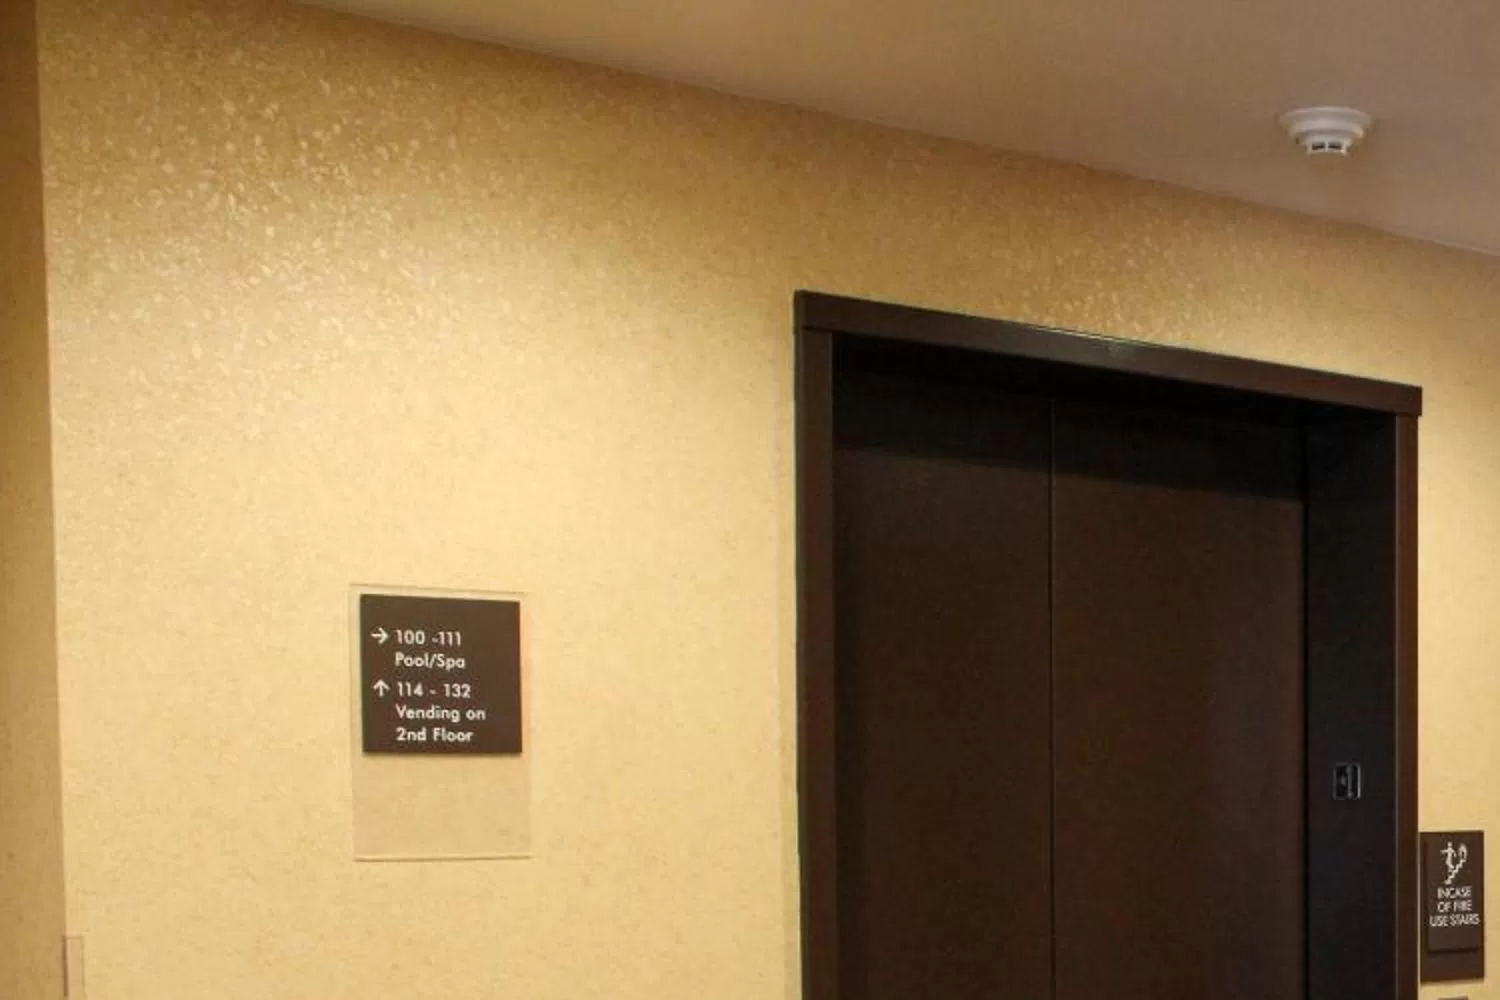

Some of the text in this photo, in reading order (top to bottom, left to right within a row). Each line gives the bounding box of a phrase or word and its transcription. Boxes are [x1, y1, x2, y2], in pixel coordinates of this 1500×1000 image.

[394, 629, 425, 645] 100
[394, 651, 466, 671] Pool/Spa
[397, 682, 424, 696] 114
[443, 683, 472, 698] 132
[395, 703, 486, 723] Vending on
[395, 726, 474, 742] 2nd Floor
[1437, 899, 1472, 912] OF FIRE
[1429, 913, 1480, 927] USE STAIRS
